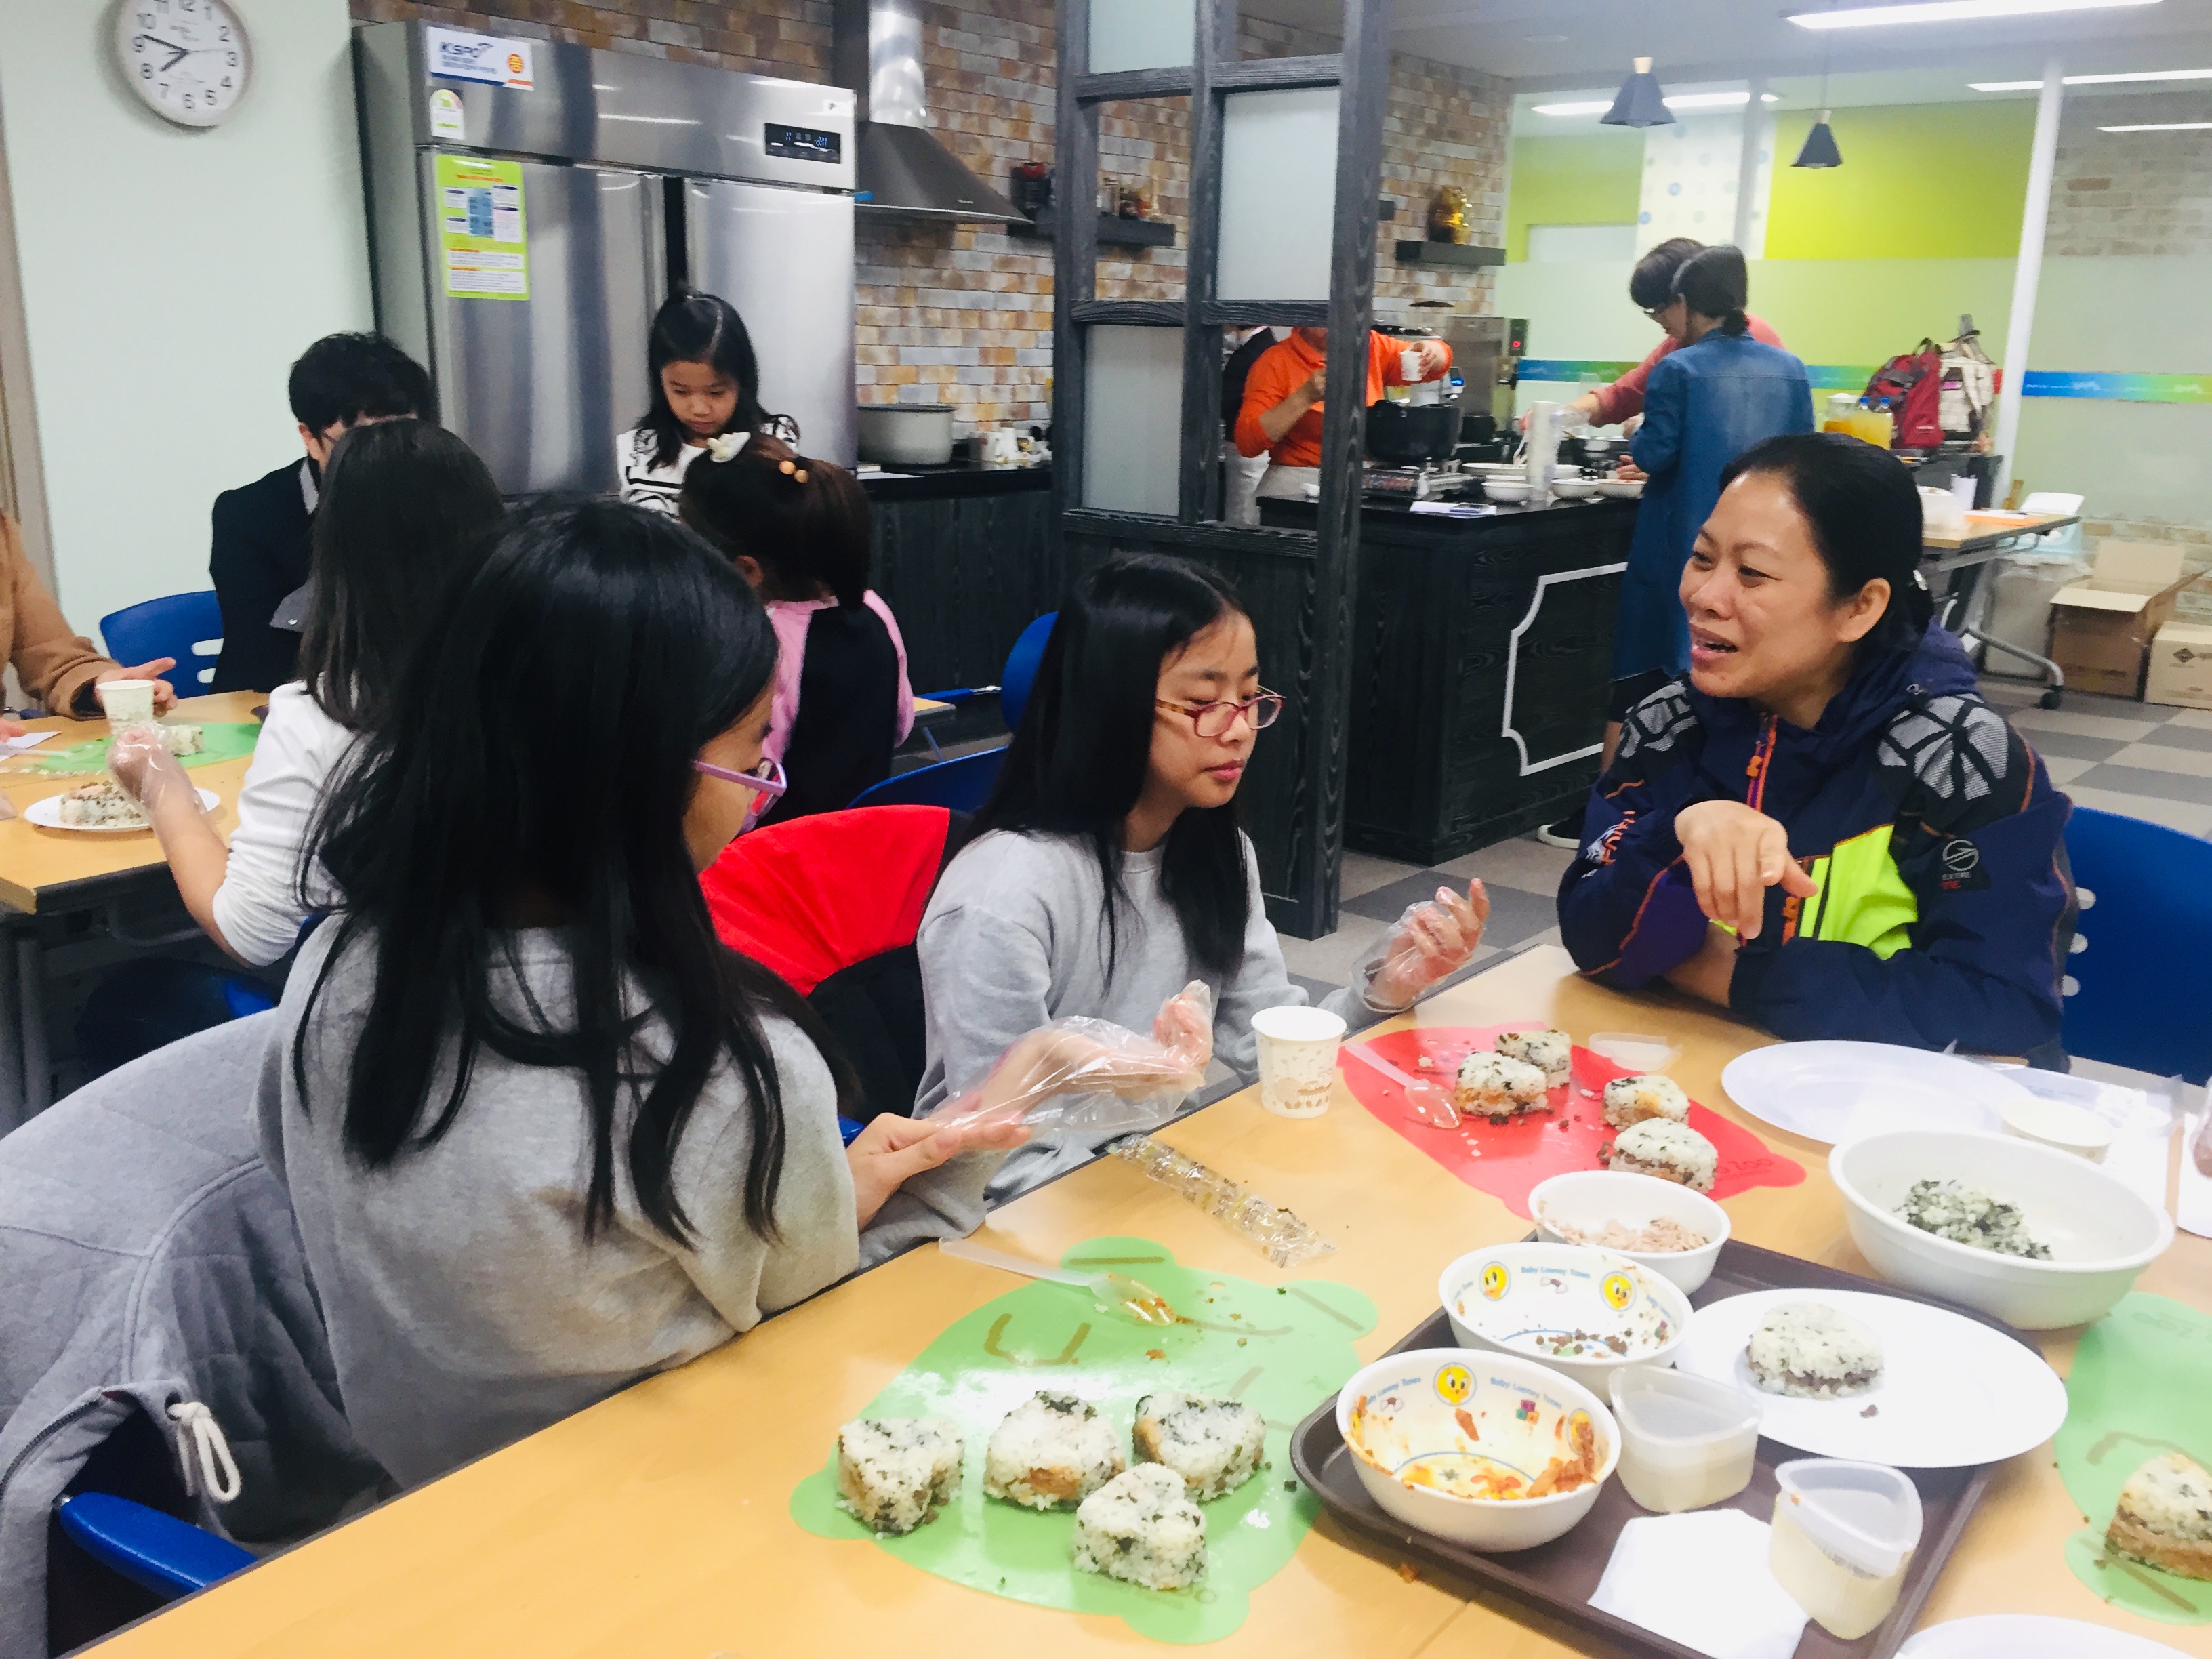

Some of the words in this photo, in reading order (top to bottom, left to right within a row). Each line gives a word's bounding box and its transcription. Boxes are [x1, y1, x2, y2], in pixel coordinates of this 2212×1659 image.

[136, 13, 157, 29] 10
[204, 6, 212, 20] 1
[218, 26, 230, 42] 2
[131, 36, 146, 53] 9
[226, 51, 238, 67] 3
[140, 62, 154, 79] 8
[220, 75, 232, 90] 4
[158, 83, 170, 99] 7
[205, 89, 218, 106] 5
[182, 94, 196, 109] 6
